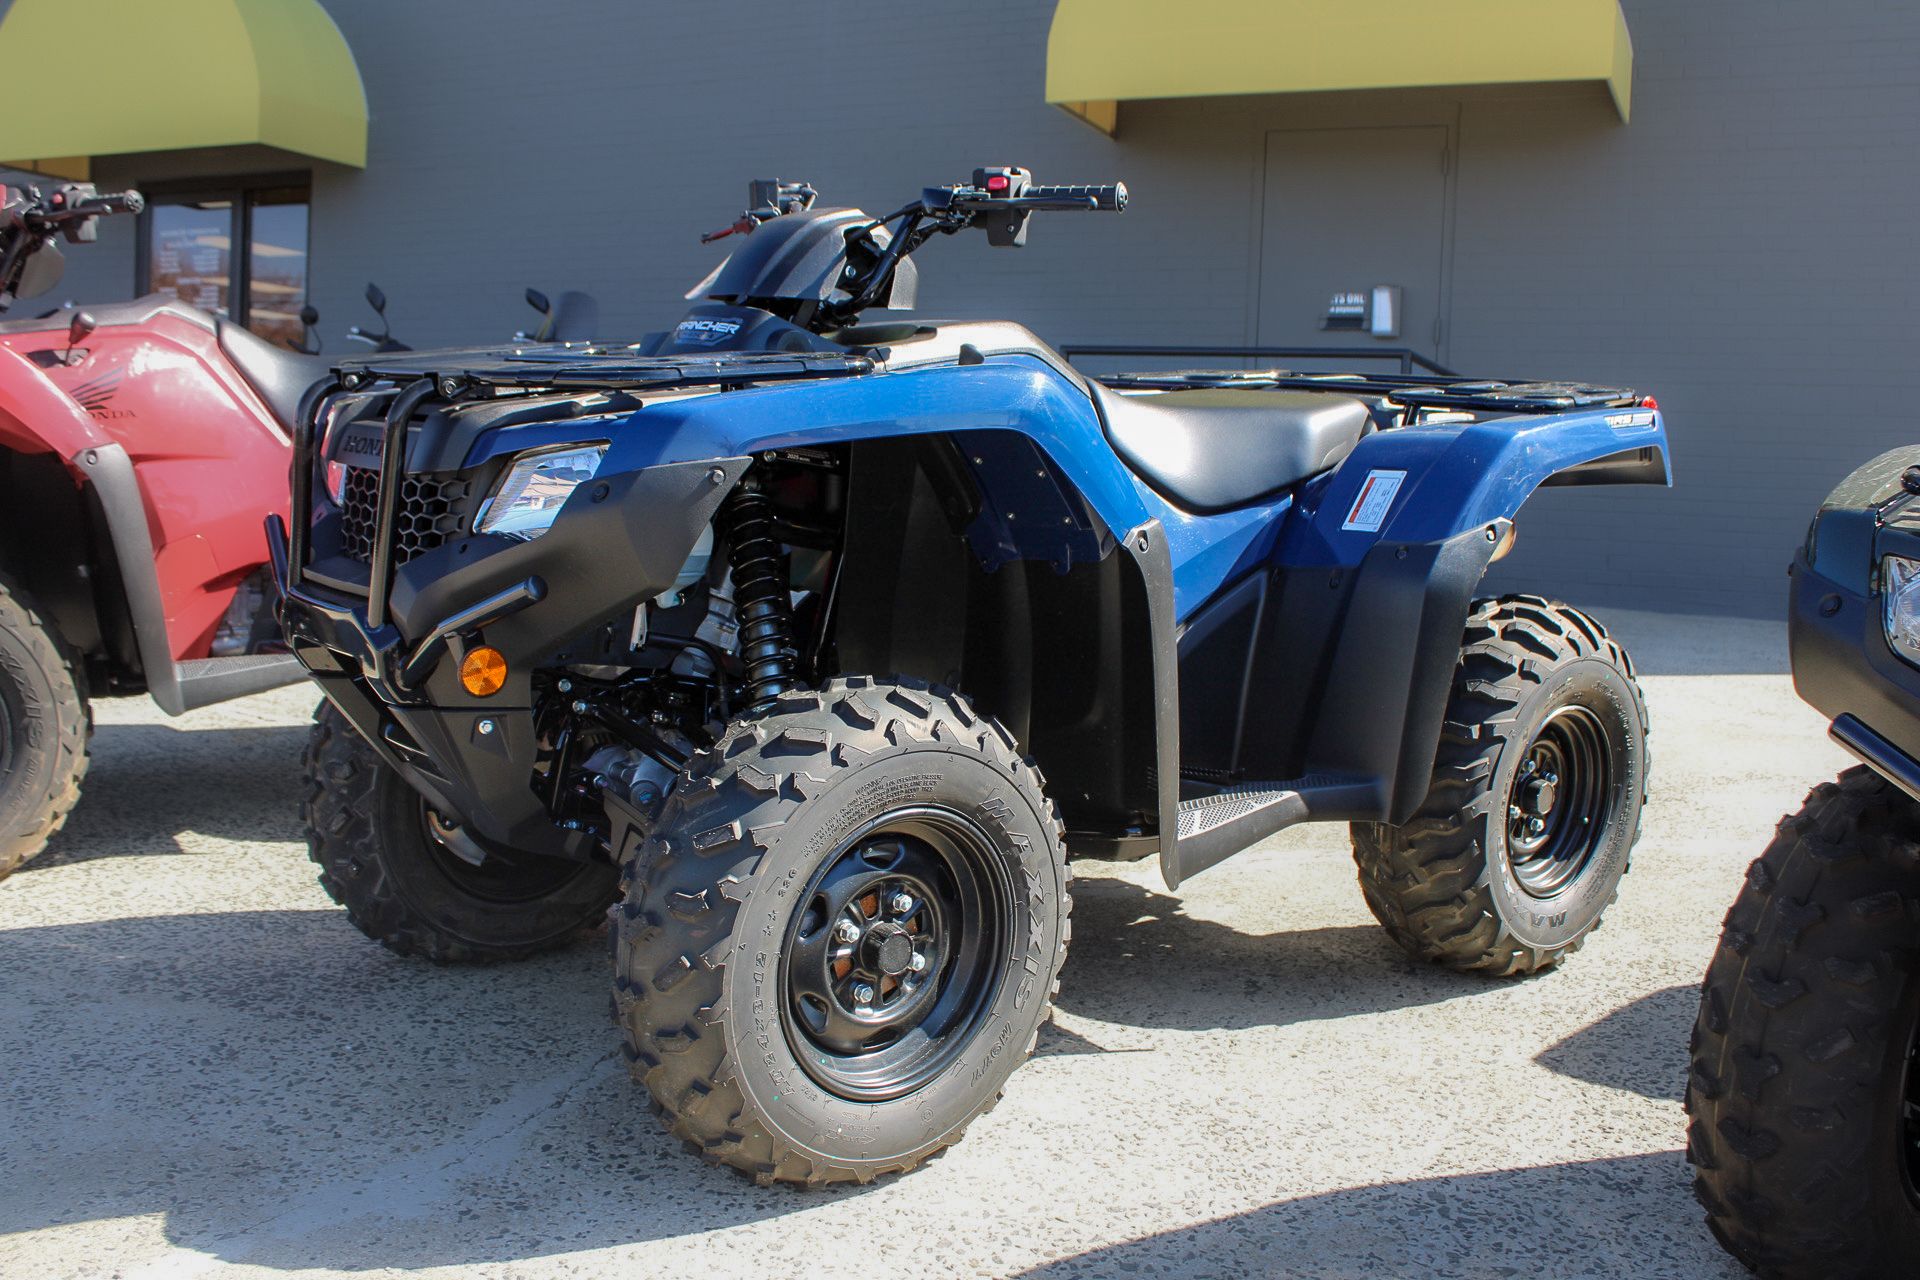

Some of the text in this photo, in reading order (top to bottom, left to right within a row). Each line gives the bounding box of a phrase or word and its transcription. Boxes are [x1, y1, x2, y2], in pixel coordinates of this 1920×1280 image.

[677, 320, 740, 335] RANCHER
[343, 434, 382, 457] HON
[977, 797, 1044, 1013] MAXXIS
